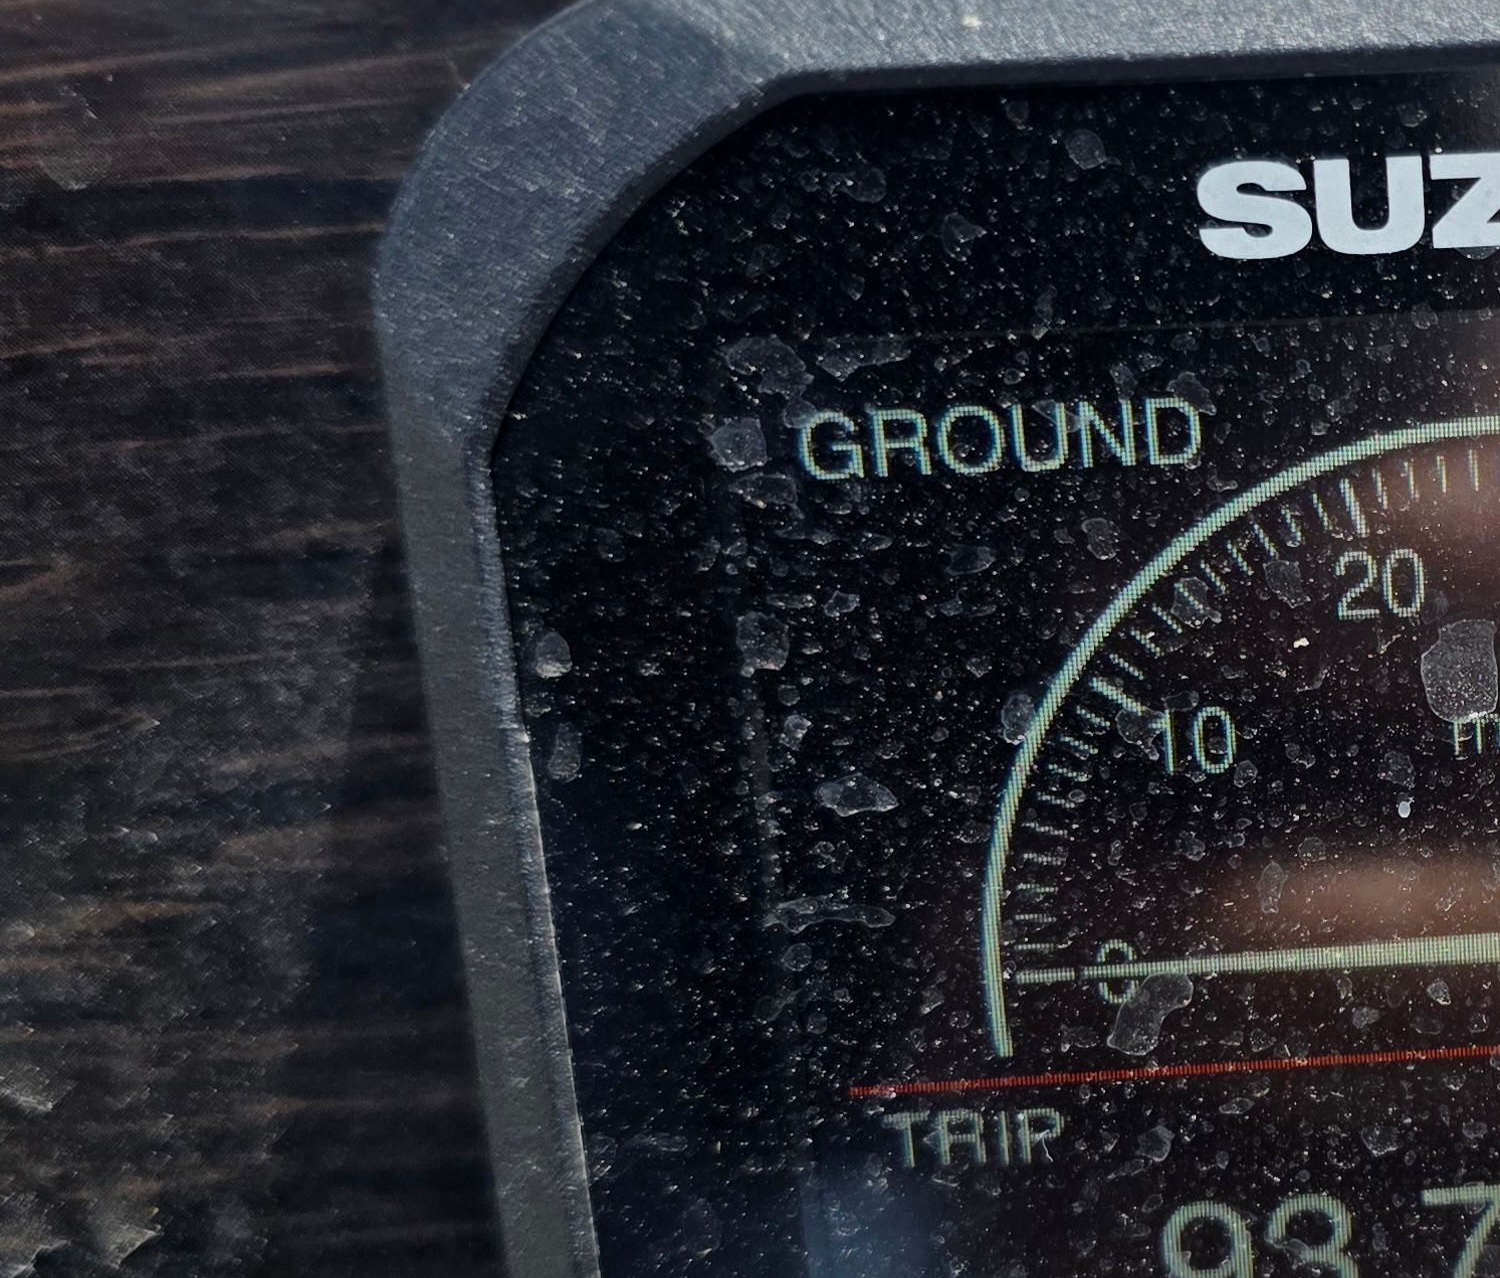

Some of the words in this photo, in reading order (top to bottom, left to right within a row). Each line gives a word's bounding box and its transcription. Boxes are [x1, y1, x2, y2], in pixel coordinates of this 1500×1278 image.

[800, 396, 1203, 481] GROUND
[1335, 548, 1425, 620] 20
[1149, 706, 1237, 774] 10
[883, 1107, 1063, 1167] TRIP
